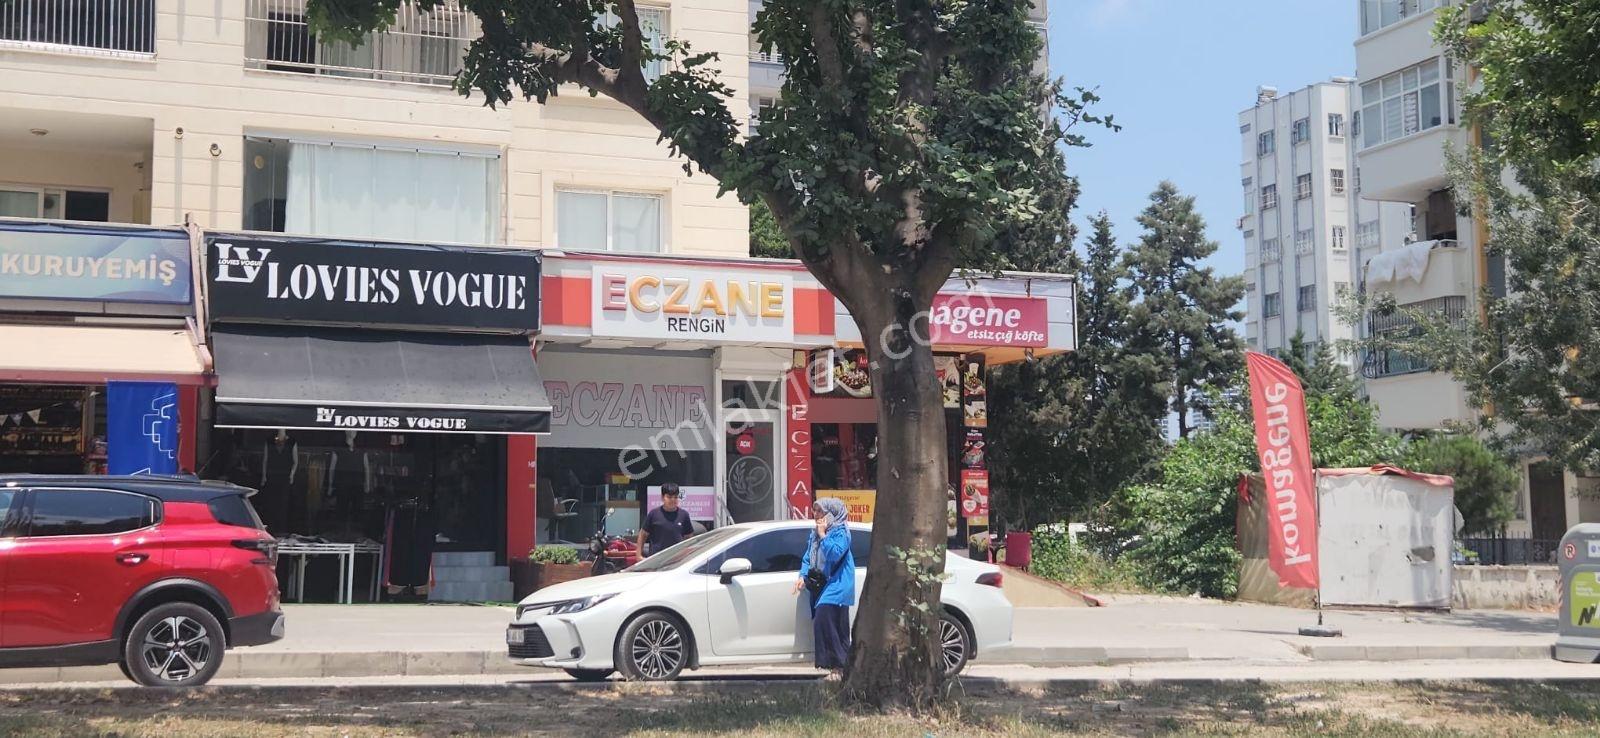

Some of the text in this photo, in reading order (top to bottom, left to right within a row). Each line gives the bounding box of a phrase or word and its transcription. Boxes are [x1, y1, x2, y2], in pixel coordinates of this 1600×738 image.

[1, 253, 177, 286] KURUYEMİŞ
[267, 262, 526, 310] LOVIES VOGUE
[602, 273, 785, 318] ECZANE
[967, 329, 994, 340] etsiz
[1015, 330, 1044, 342] köfte
[334, 415, 399, 428] LOVIES
[406, 417, 467, 430] VOGUE
[543, 380, 707, 429] ECZANE
[1263, 382, 1312, 566] komagene
[850, 504, 870, 513] JOKER
